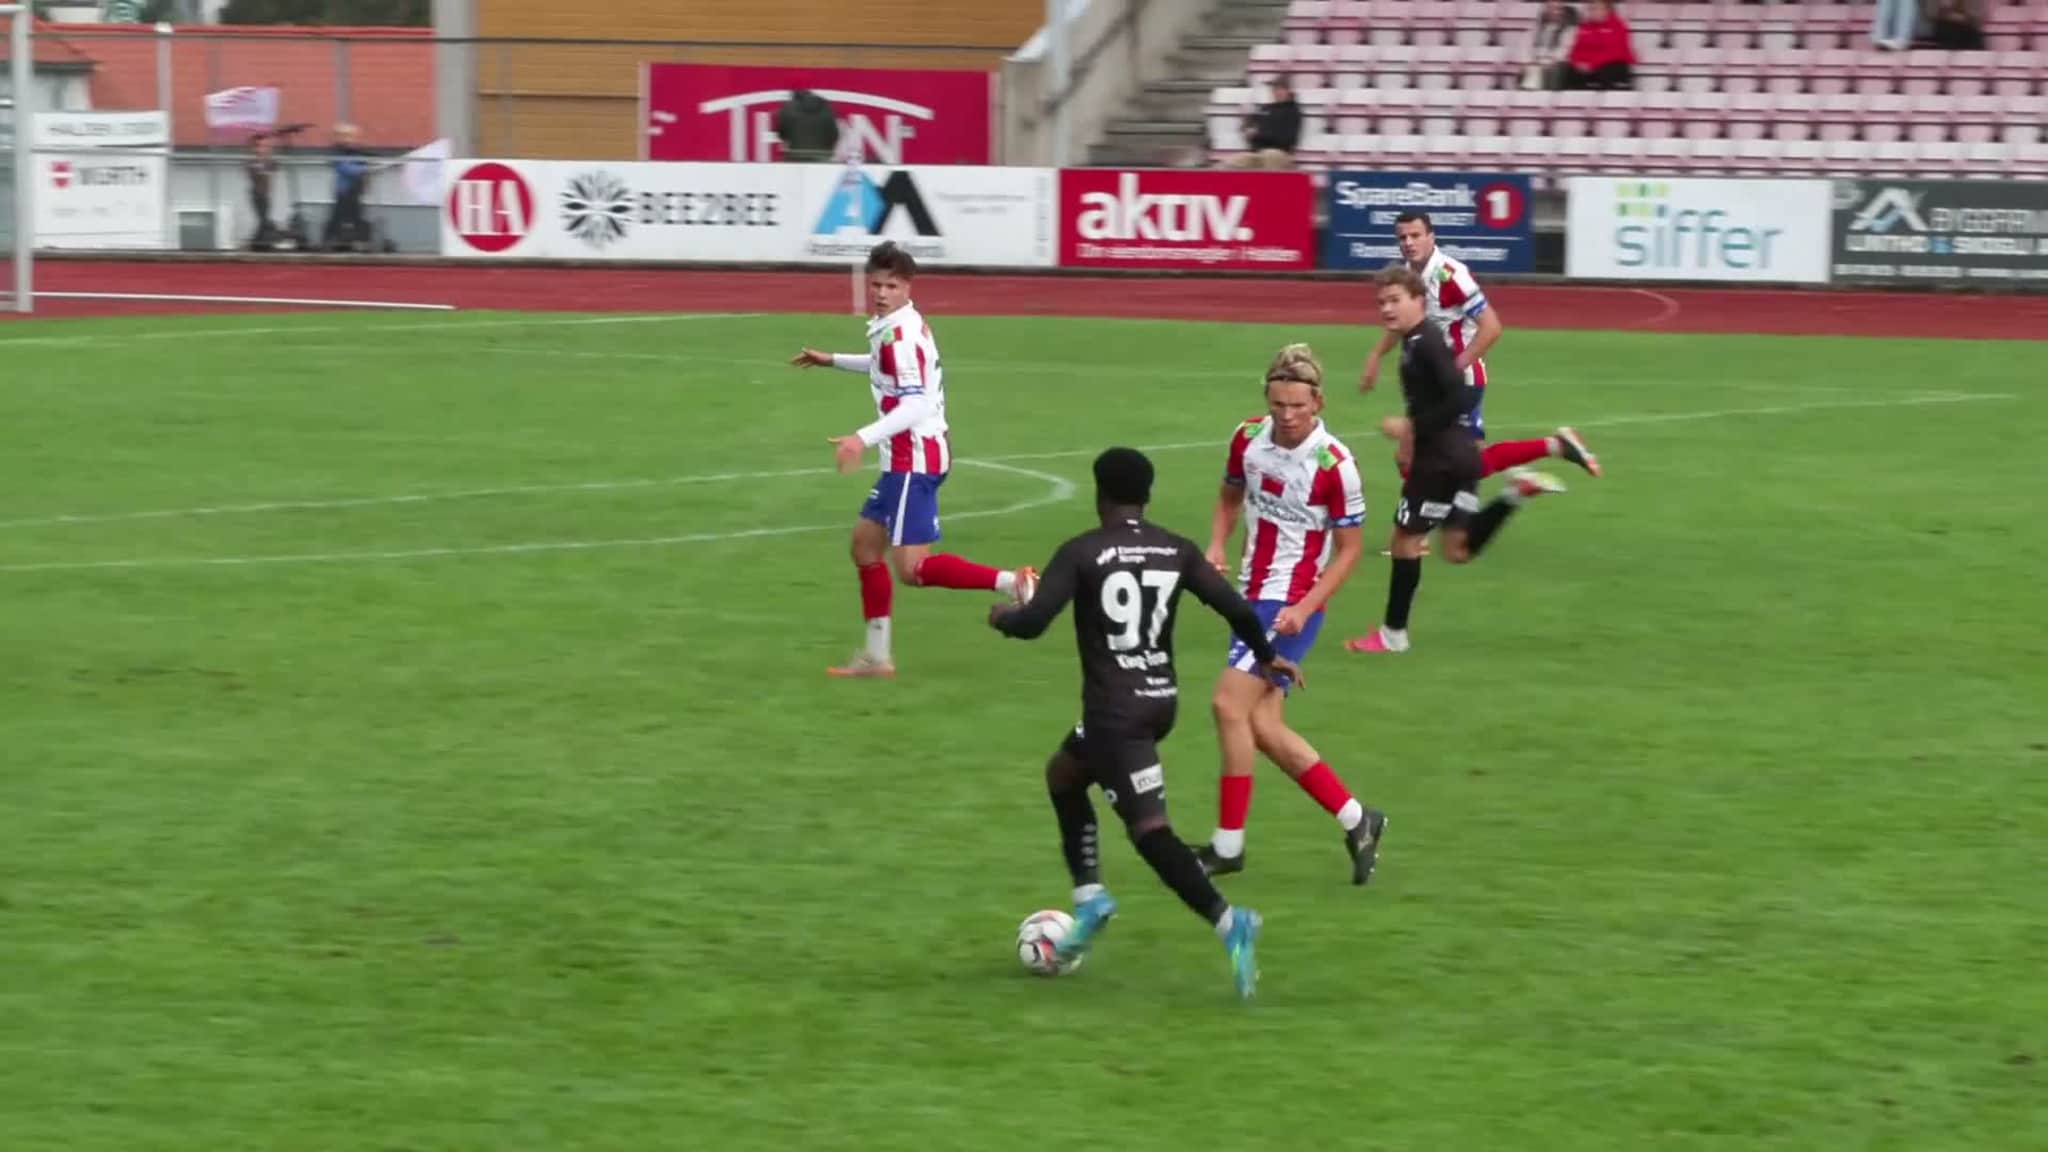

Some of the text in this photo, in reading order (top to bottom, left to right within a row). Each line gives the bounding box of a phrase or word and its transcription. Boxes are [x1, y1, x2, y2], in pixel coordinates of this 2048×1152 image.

[639, 191, 780, 227] BEE2BEE
[1335, 181, 1477, 209] SpareBank
[1614, 203, 1784, 268] siffer
[1102, 569, 1181, 650] 97
